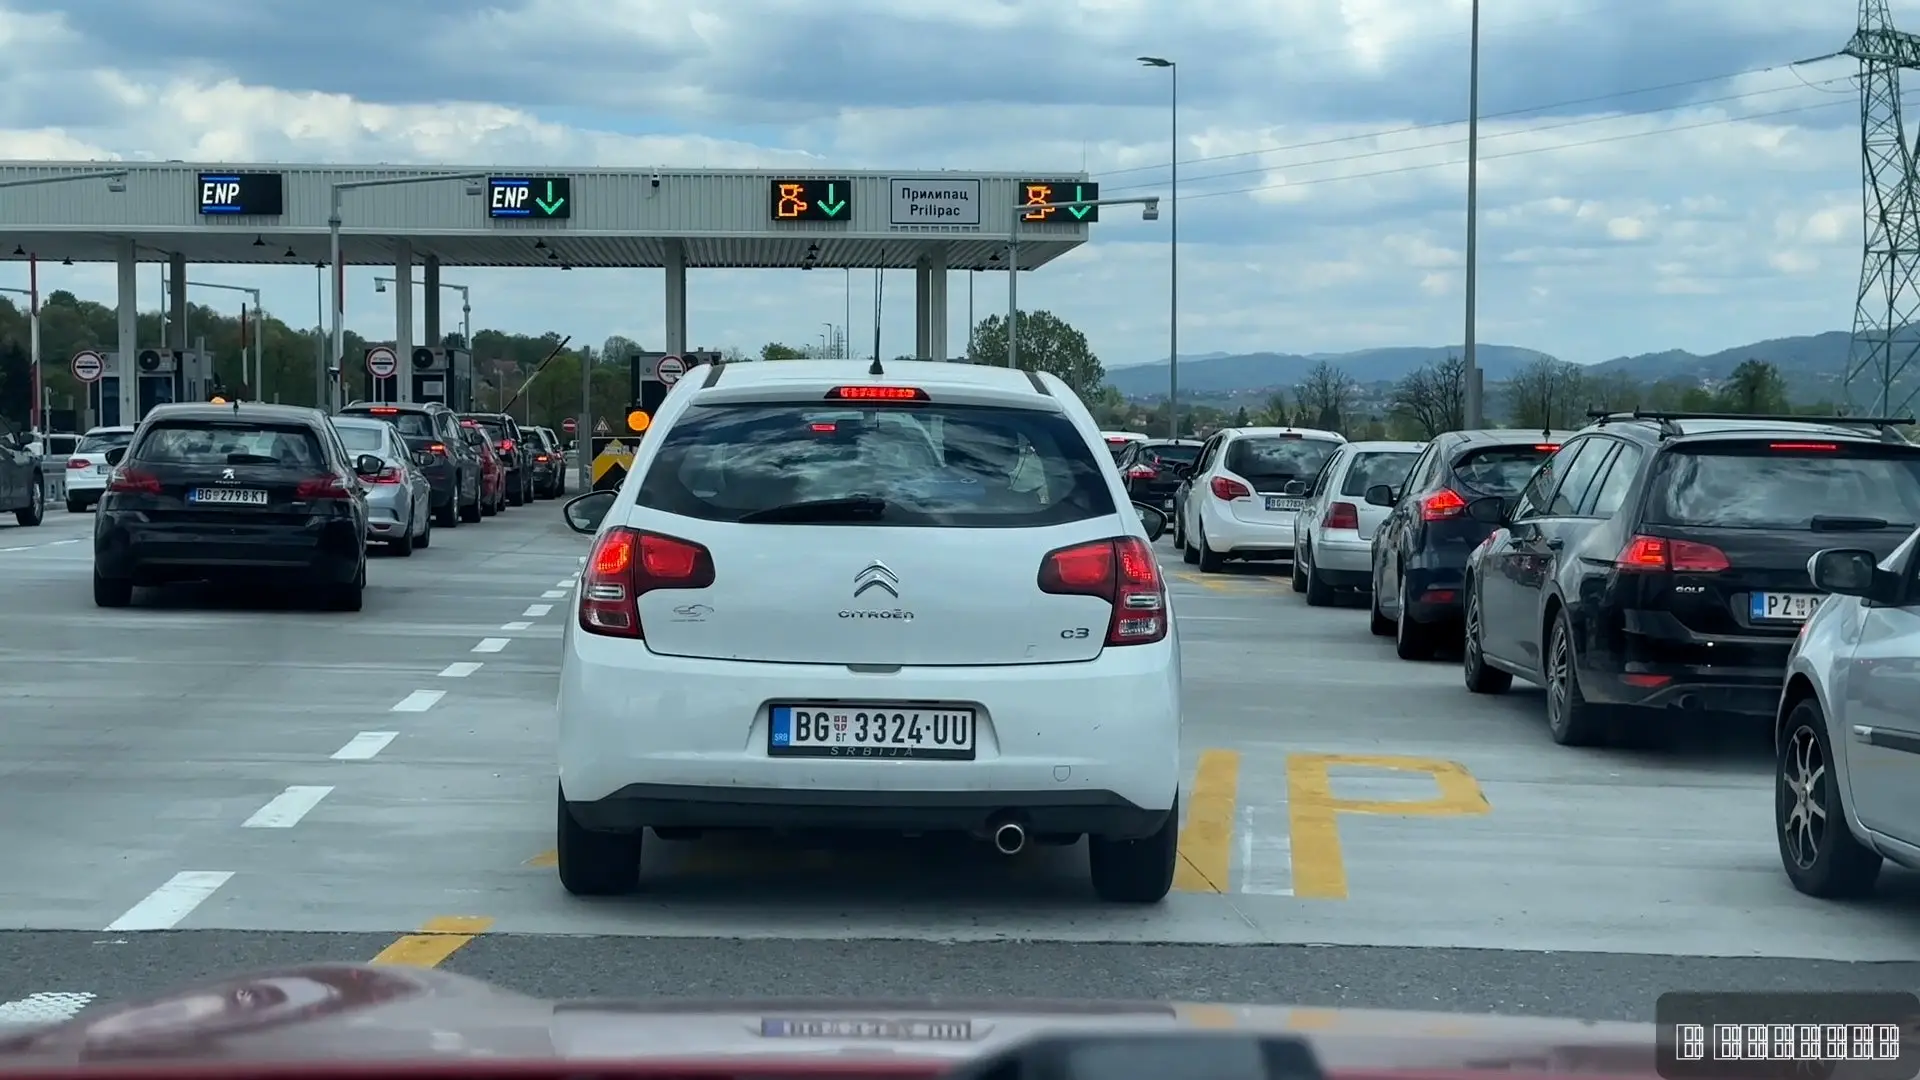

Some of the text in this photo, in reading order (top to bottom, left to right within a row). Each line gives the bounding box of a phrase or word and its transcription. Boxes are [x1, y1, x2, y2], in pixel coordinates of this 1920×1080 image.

[202, 182, 240, 204] ENP
[492, 186, 529, 208] ENP
[902, 187, 969, 201] Прилипац
[910, 203, 961, 218] Prilipac
[197, 489, 212, 500] BG
[1060, 627, 1090, 639] C3
[796, 711, 830, 742] BG
[774, 732, 788, 742] SRB
[830, 745, 914, 757] SRBIJA
